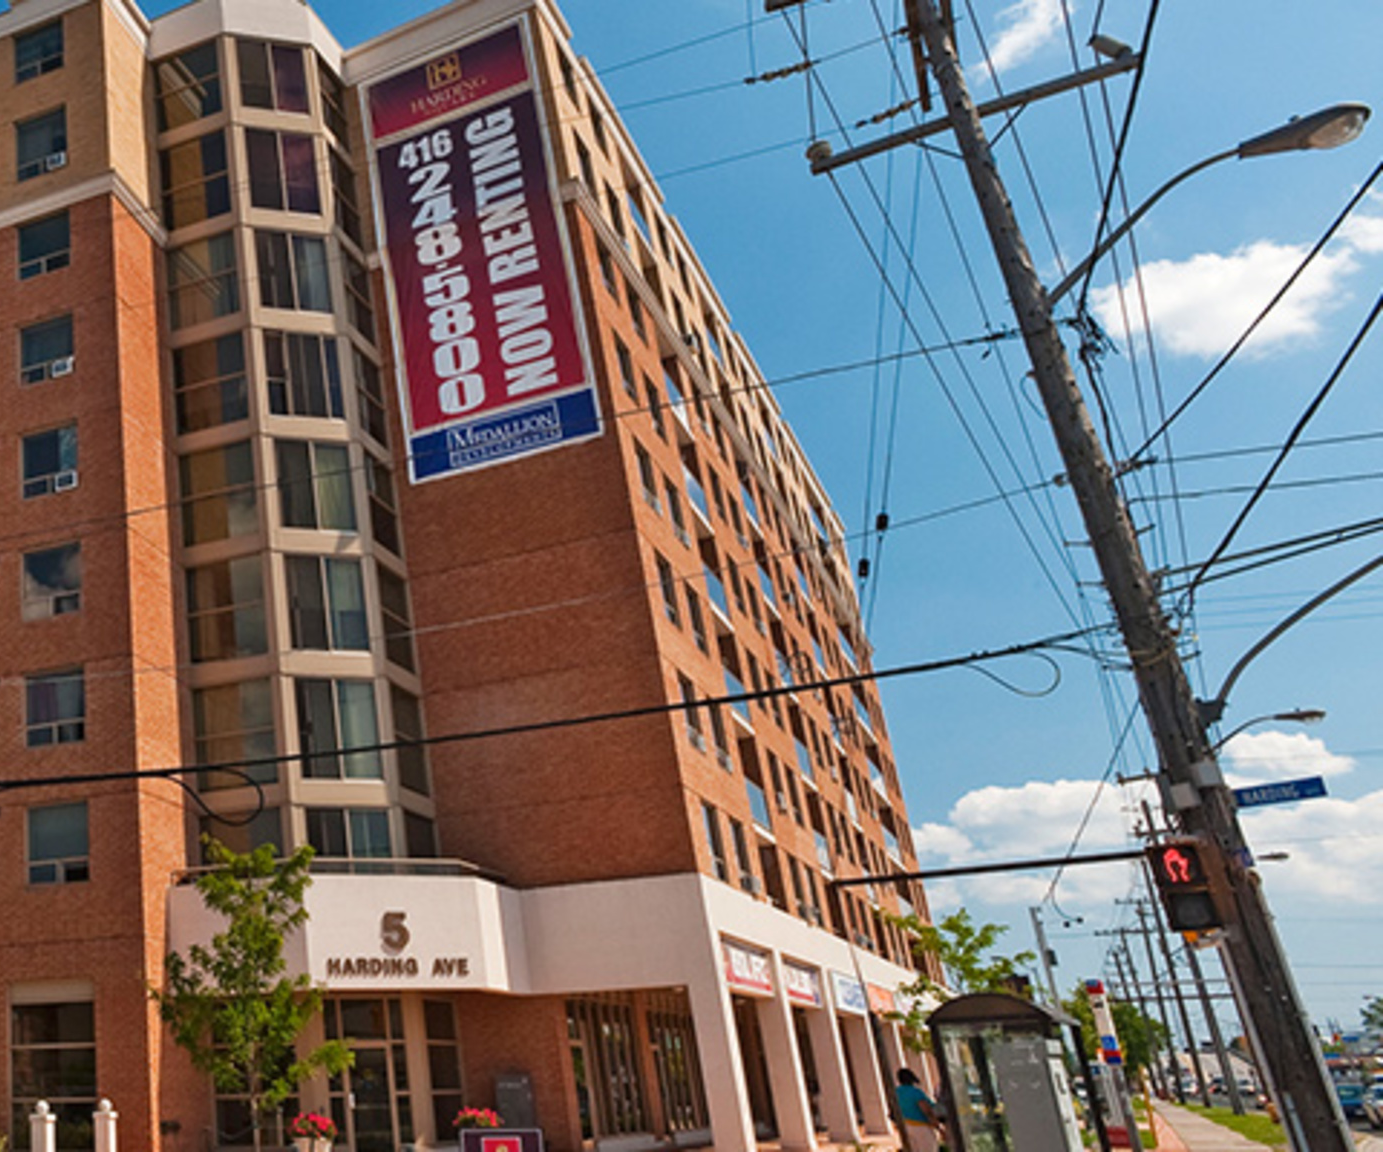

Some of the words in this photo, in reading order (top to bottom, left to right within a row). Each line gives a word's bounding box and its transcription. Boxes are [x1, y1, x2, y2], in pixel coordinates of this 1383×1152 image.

[410, 77, 488, 115] HARDING
[398, 129, 453, 168] 416
[464, 106, 540, 285] RENTING
[492, 284, 558, 396] NOW
[1241, 783, 1300, 803] HARDING
[381, 911, 411, 956] 5
[327, 958, 419, 977] HARDING
[432, 958, 470, 977] AVE
